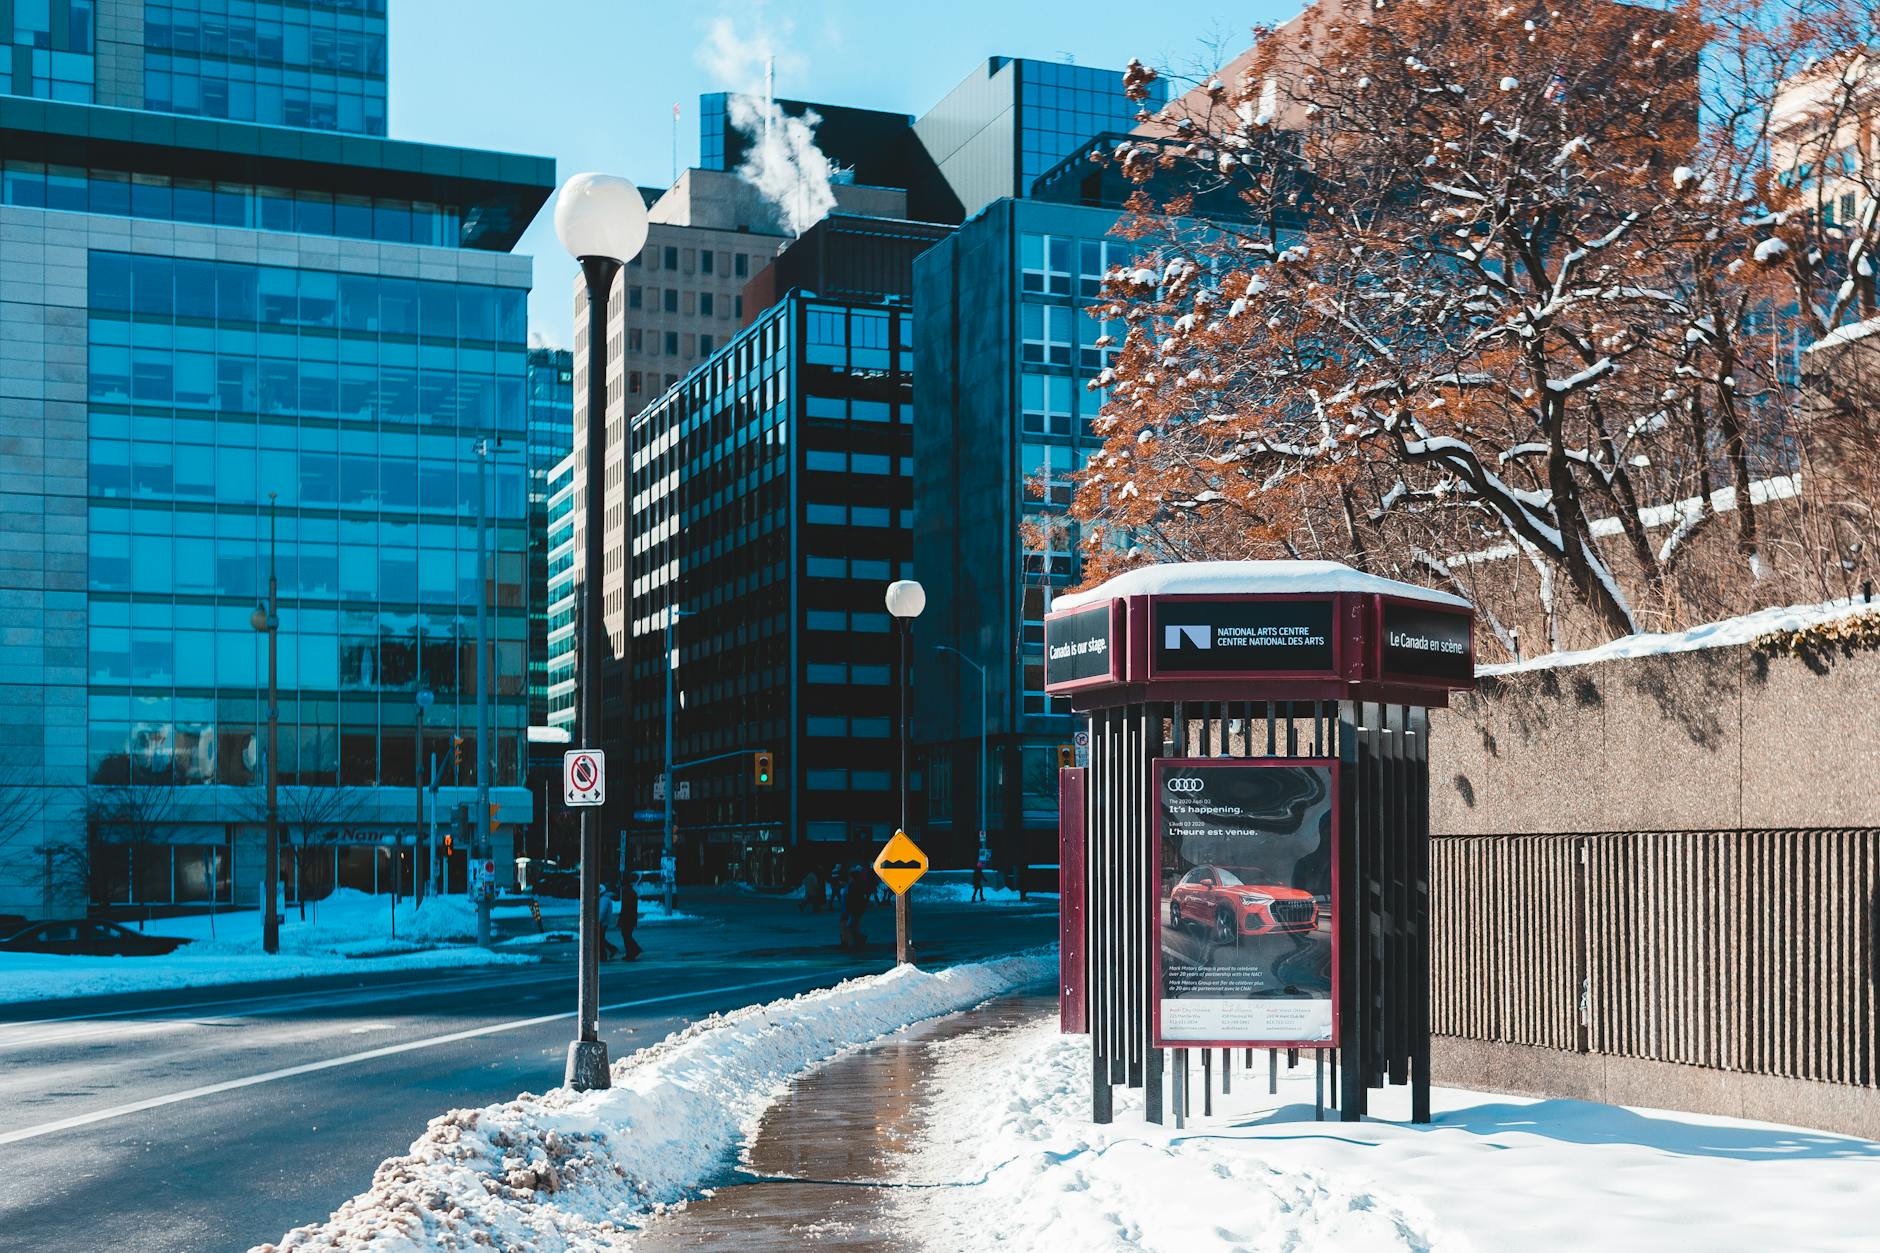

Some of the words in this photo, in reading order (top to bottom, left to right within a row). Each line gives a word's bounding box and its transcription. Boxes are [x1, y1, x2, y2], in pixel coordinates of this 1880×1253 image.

[1217, 627, 1256, 637] NATIONAL
[1257, 627, 1277, 636] ARTS
[1278, 627, 1309, 636] CENTRE
[1217, 637, 1248, 646] CENTRE
[1248, 637, 1287, 646] NATIONAL
[1287, 637, 1303, 646] DES
[1304, 637, 1325, 646] ARTS
[1390, 631, 1400, 647] Le
[1400, 632, 1429, 650] Canada
[1429, 639, 1440, 651] en
[1440, 638, 1464, 654] scène.
[1050, 642, 1071, 660] Canada
[1071, 641, 1077, 656] is
[1077, 641, 1088, 655] our
[1088, 637, 1107, 654] stage.
[1188, 806, 1243, 815] happening.
[1169, 828, 1205, 836] L'heure
